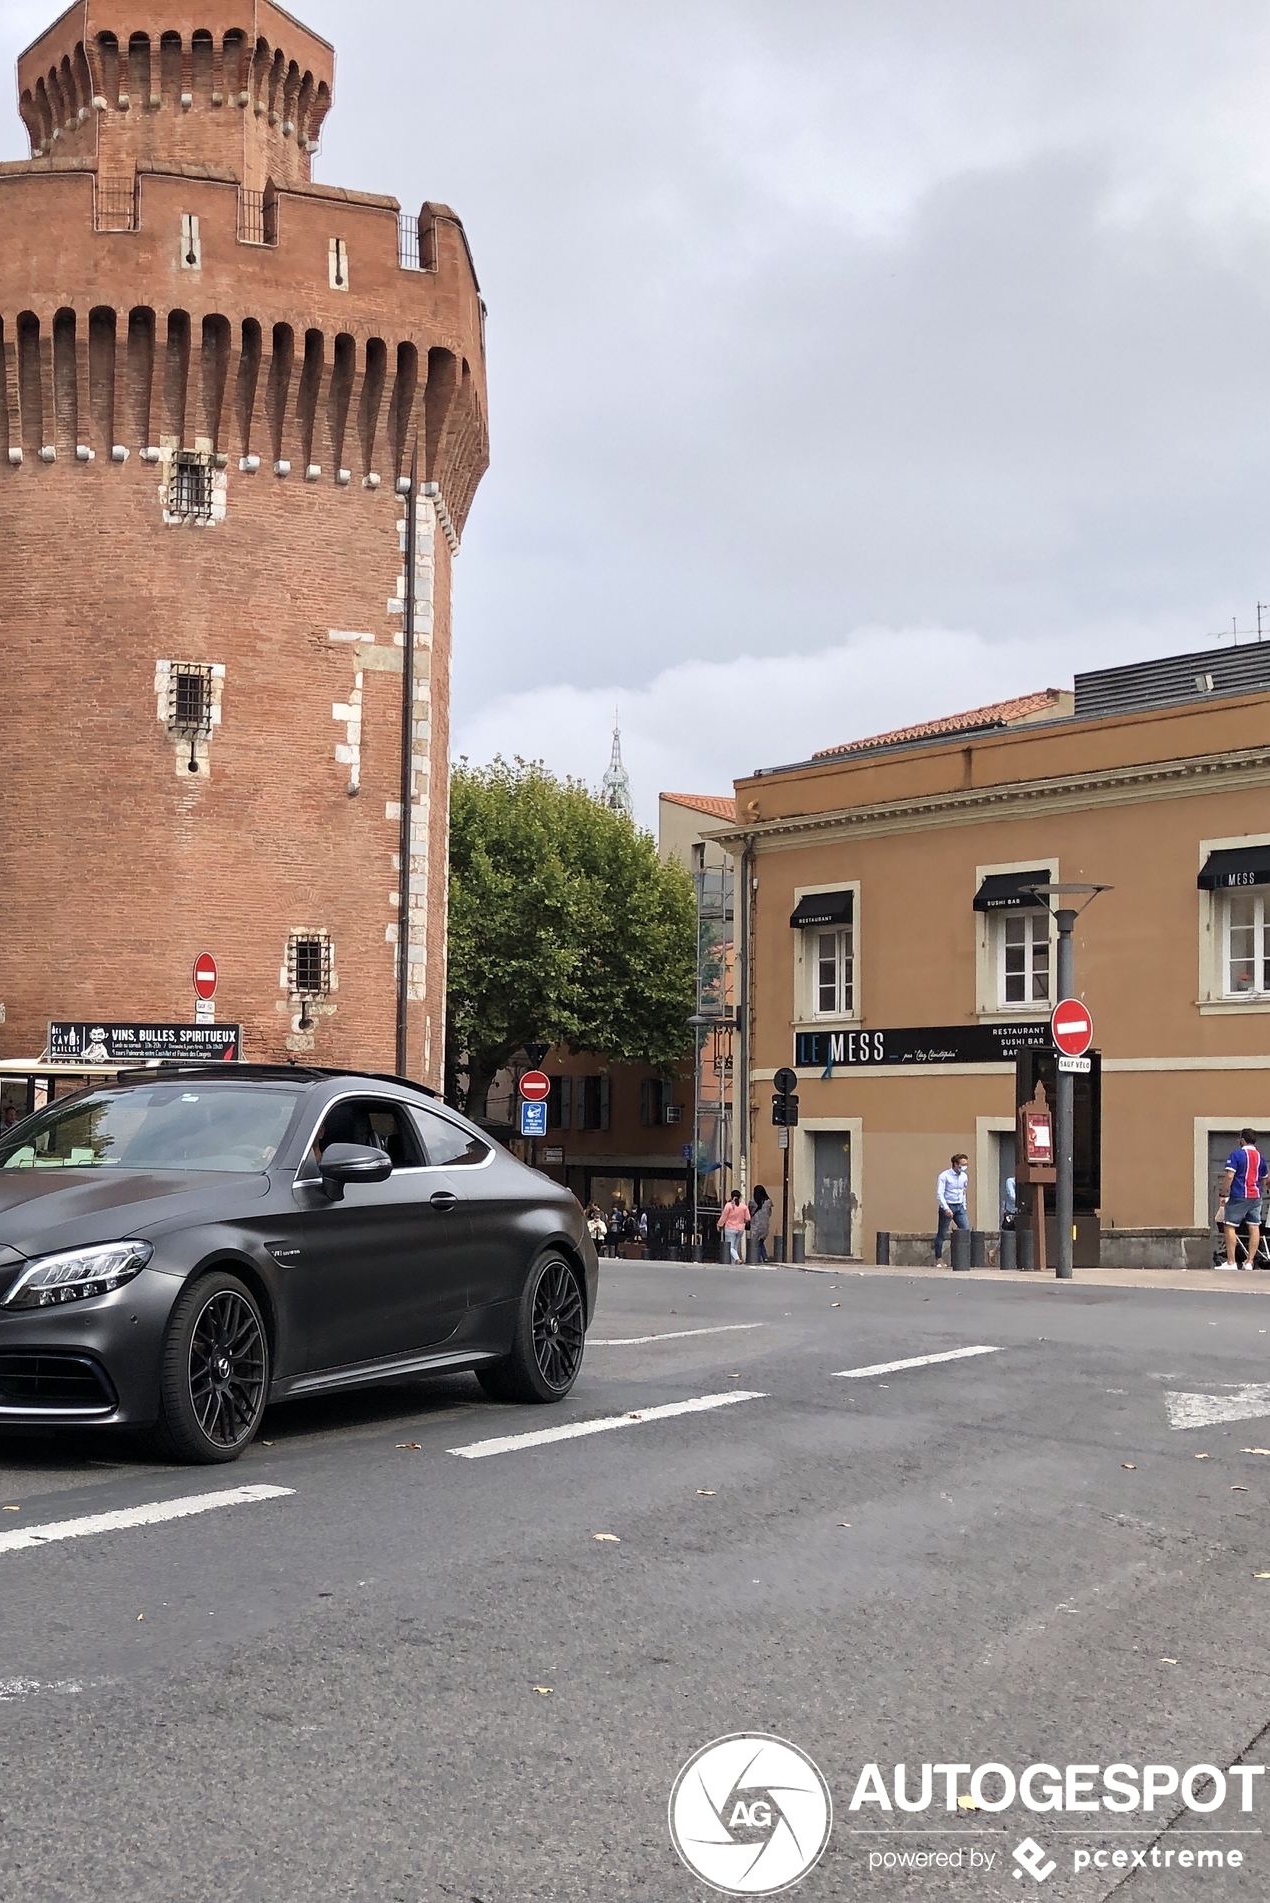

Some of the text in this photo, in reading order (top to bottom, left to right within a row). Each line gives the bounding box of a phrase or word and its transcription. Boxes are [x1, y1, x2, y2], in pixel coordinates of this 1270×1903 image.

[1228, 872, 1255, 886] MESS
[986, 899, 1006, 907] SUSHI
[798, 915, 833, 924] RESTAURANT
[992, 1026, 1045, 1035] RESTAURANT
[112, 1029, 236, 1043] VINS, BULLES, SPIRITUEUX
[1000, 1037, 1045, 1046] SUSHI BAR
[801, 1032, 884, 1063] LE MESS
[1060, 1060, 1074, 1068] SAUF
